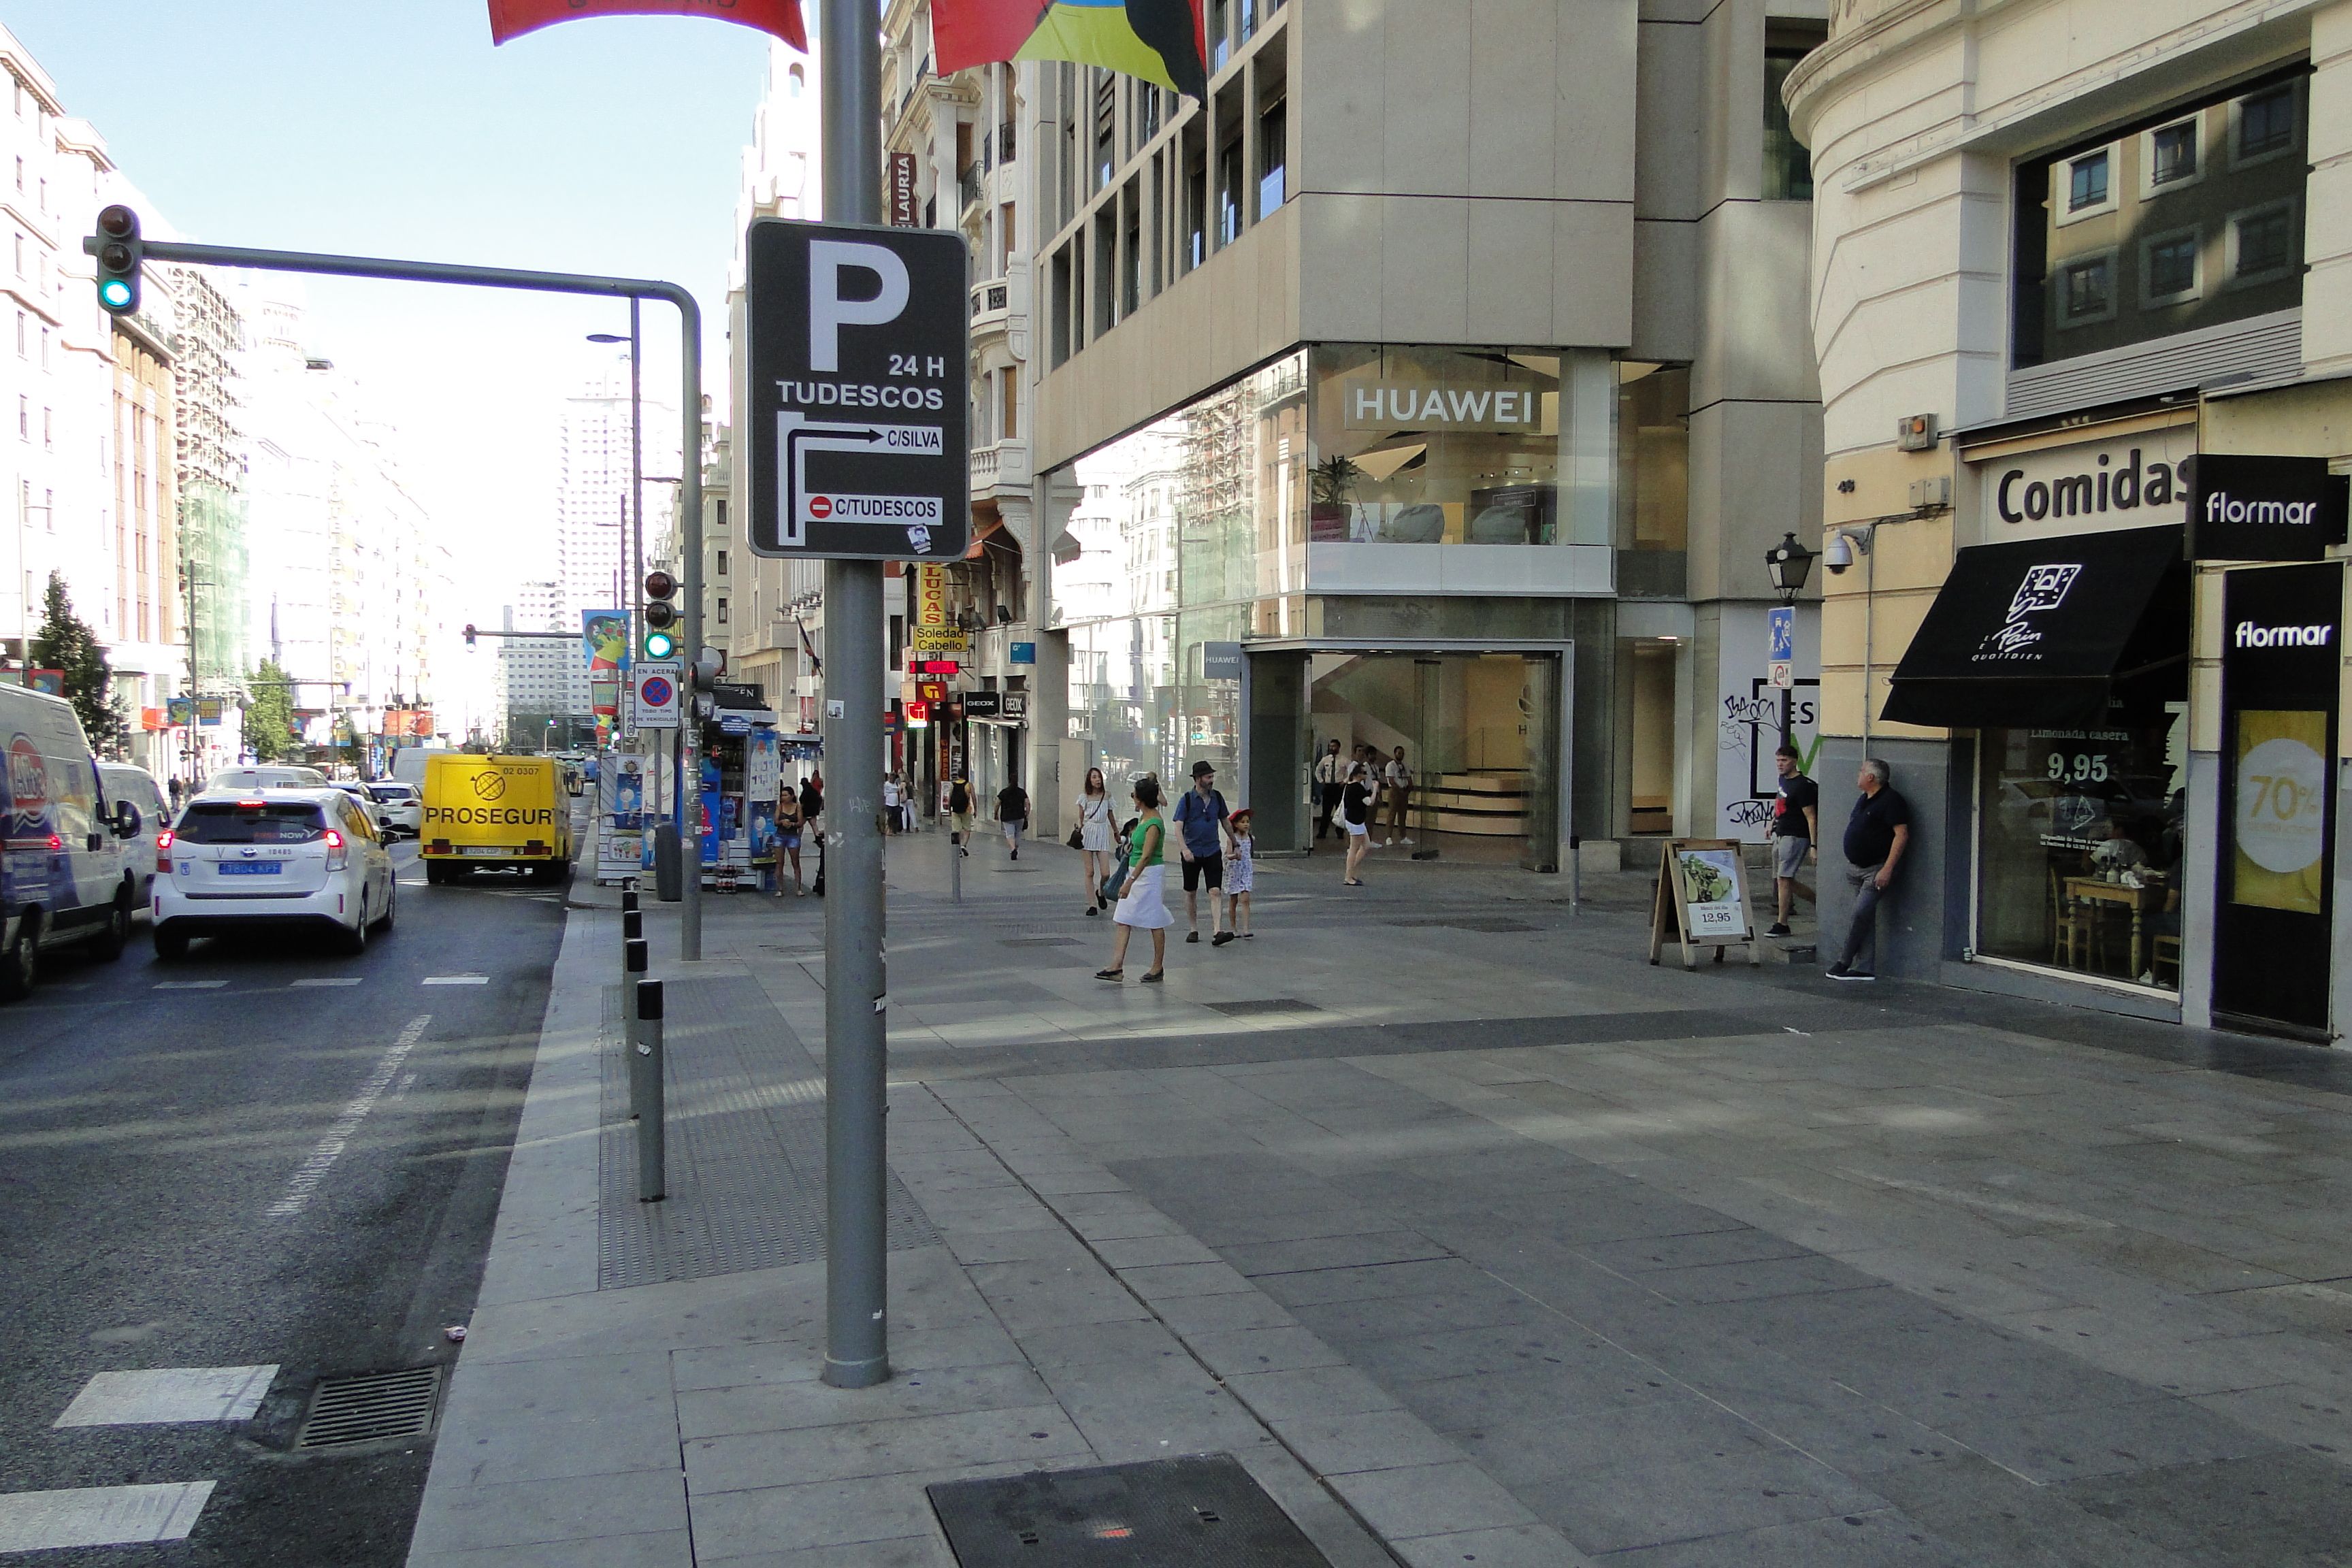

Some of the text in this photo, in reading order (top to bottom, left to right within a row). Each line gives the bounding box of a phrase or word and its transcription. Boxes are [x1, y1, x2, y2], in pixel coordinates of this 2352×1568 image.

[898, 157, 911, 222] LAURIA
[809, 240, 910, 372] P
[889, 354, 945, 378] 24 H
[775, 380, 944, 410] TUDESCOS
[1356, 388, 1532, 423] HUAWEI
[887, 429, 940, 448] C/SILVA
[836, 498, 936, 517] C/TUDESCOS
[2206, 491, 2317, 525] flormar
[918, 640, 962, 651] Cabello
[1991, 621, 2042, 652] Pain
[2235, 621, 2332, 649] flormar
[1972, 653, 2042, 662] QUOTIDIEN
[1005, 697, 1022, 711] GEOX
[2089, 730, 2129, 741] casera
[2048, 752, 2108, 785] 9,95
[425, 807, 552, 825] PROSEGUR
[1702, 913, 1731, 924] 12,95
